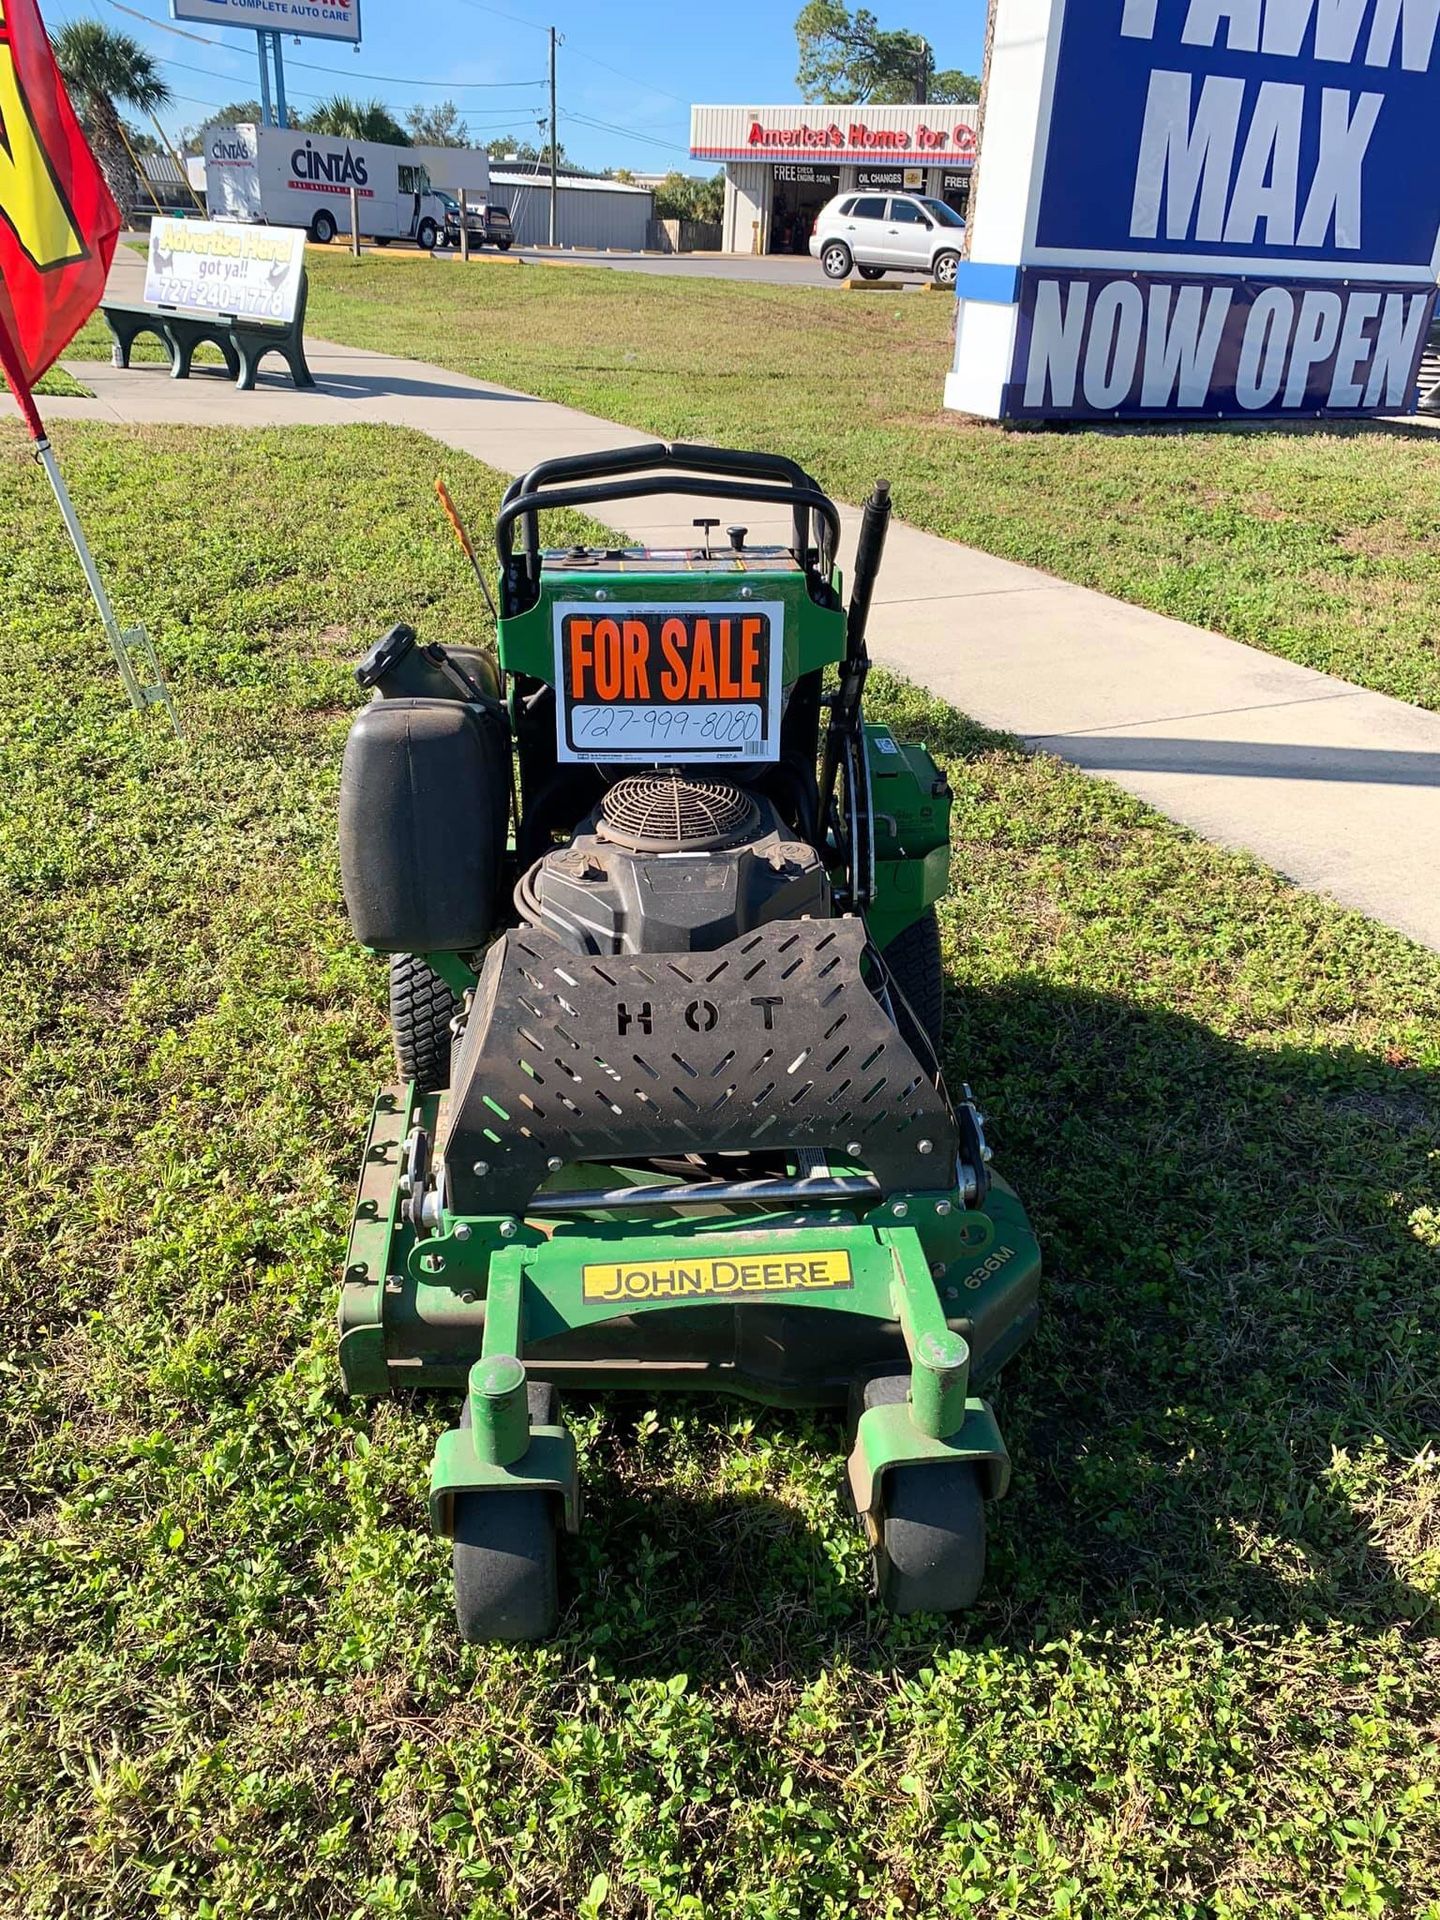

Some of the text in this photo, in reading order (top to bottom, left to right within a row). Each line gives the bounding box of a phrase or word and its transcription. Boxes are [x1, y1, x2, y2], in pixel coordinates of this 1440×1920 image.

[231, 0, 288, 14] COMPLETE
[291, 4, 319, 17] AUTO
[322, 9, 349, 21] CARE
[748, 122, 844, 148] America's
[848, 124, 911, 149] Home
[915, 123, 949, 149] for
[774, 164, 797, 181] FREE
[1129, 68, 1385, 250] MAX
[858, 172, 902, 184] OIL CHANGES
[944, 176, 969, 188] FREE
[160, 223, 241, 258] Advertise
[199, 259, 249, 281] got ya!!
[159, 278, 285, 317] 727-240-1778
[1023, 280, 1428, 410] NOW OPEN
[570, 617, 761, 701] FOR SALE
[580, 707, 759, 742] 727-999-8080
[617, 996, 784, 1036] HOT
[603, 1260, 831, 1297] JOHN DEERE
[963, 1245, 1016, 1290] 636M
